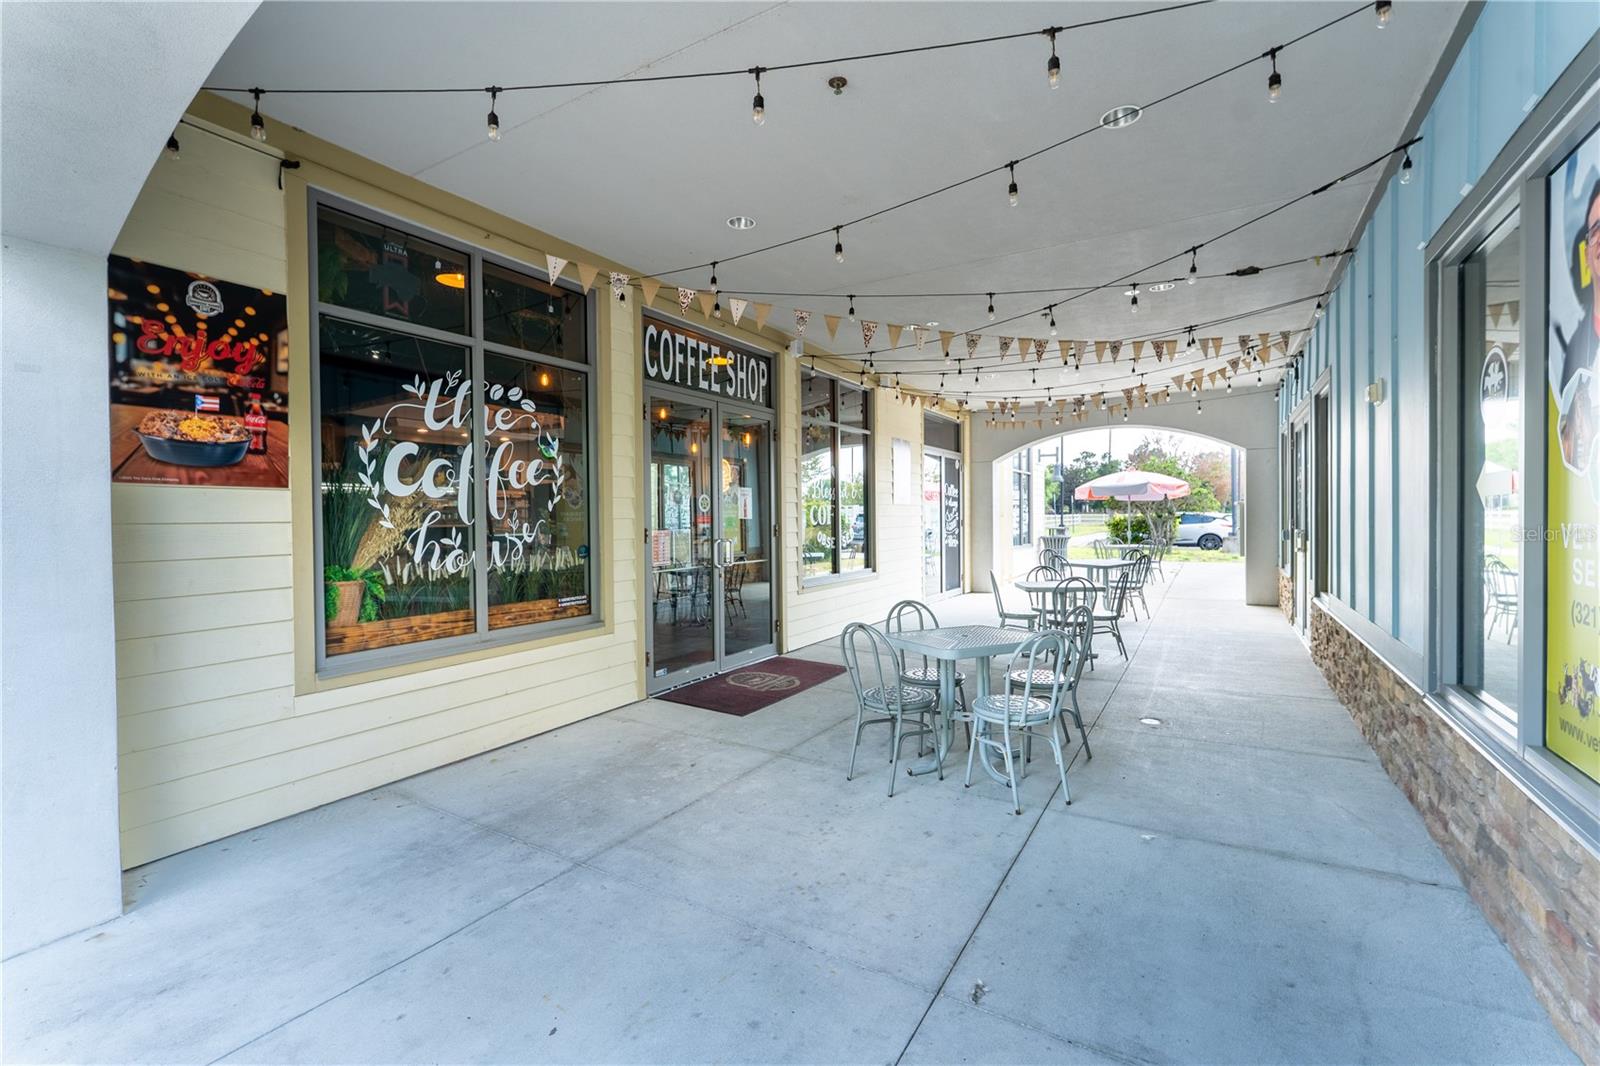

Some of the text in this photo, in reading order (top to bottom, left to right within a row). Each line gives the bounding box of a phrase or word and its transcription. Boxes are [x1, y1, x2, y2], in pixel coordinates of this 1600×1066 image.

[137, 319, 260, 375] Enjoy
[645, 324, 768, 403] COFFEE SHOP
[384, 377, 530, 436] the
[383, 440, 551, 526] Coffee
[406, 511, 546, 573] house
[1571, 599, 1600, 630] (321
[1559, 716, 1600, 753] www.ve
